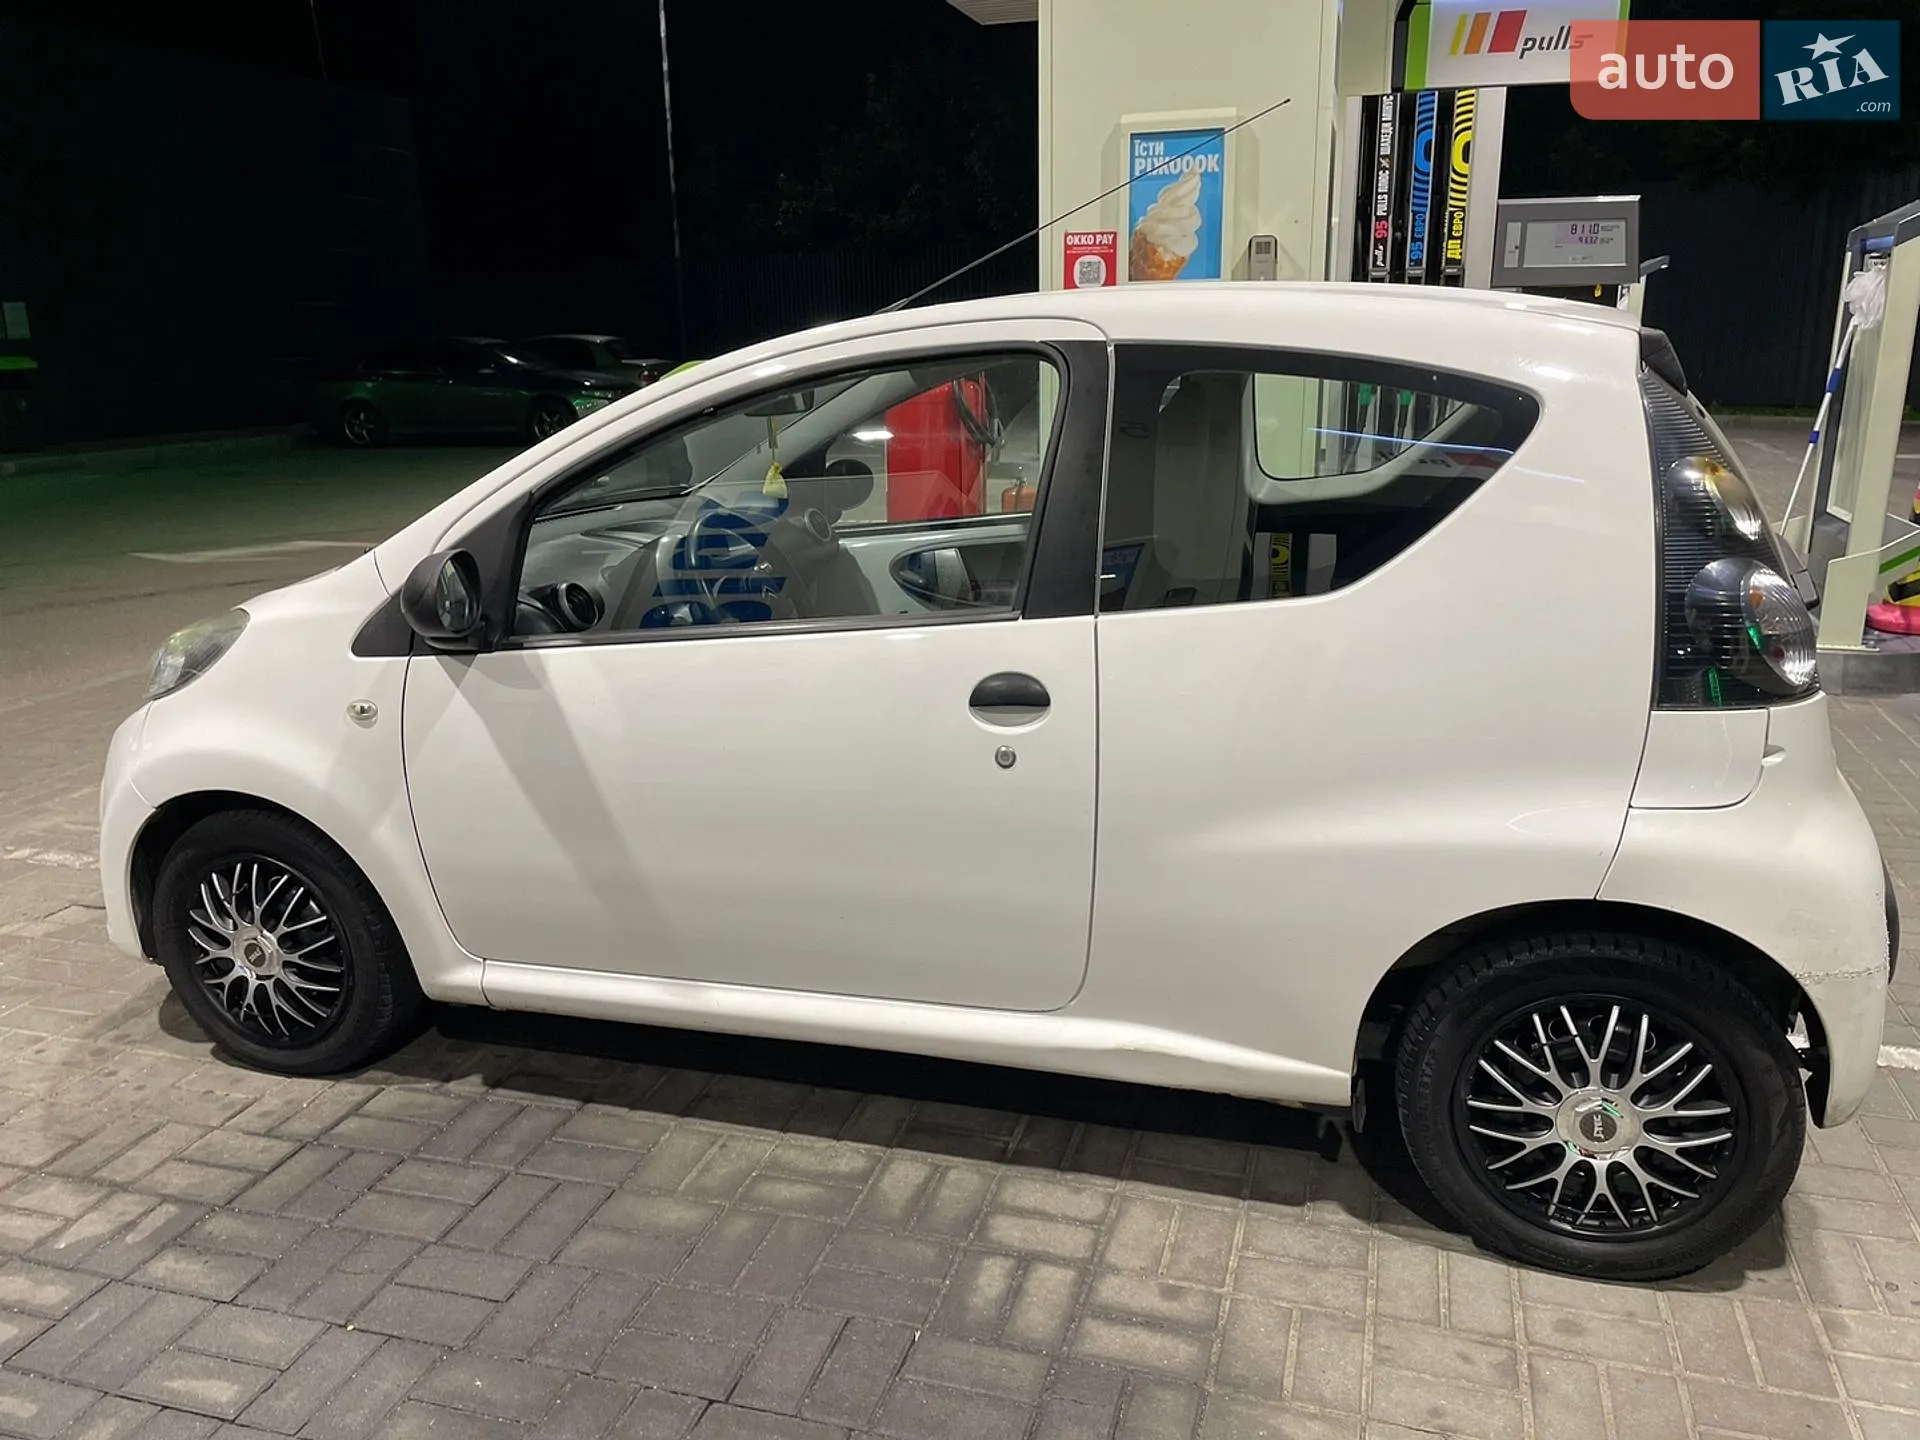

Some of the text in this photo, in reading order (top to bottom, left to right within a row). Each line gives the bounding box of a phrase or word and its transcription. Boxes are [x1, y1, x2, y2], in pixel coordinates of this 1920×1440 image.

[1518, 25, 1594, 60] pulls
[1375, 220, 1388, 239] 95
[1095, 233, 1115, 246] PAY
[1411, 241, 1423, 260] 95
[1447, 239, 1462, 260] ДП
